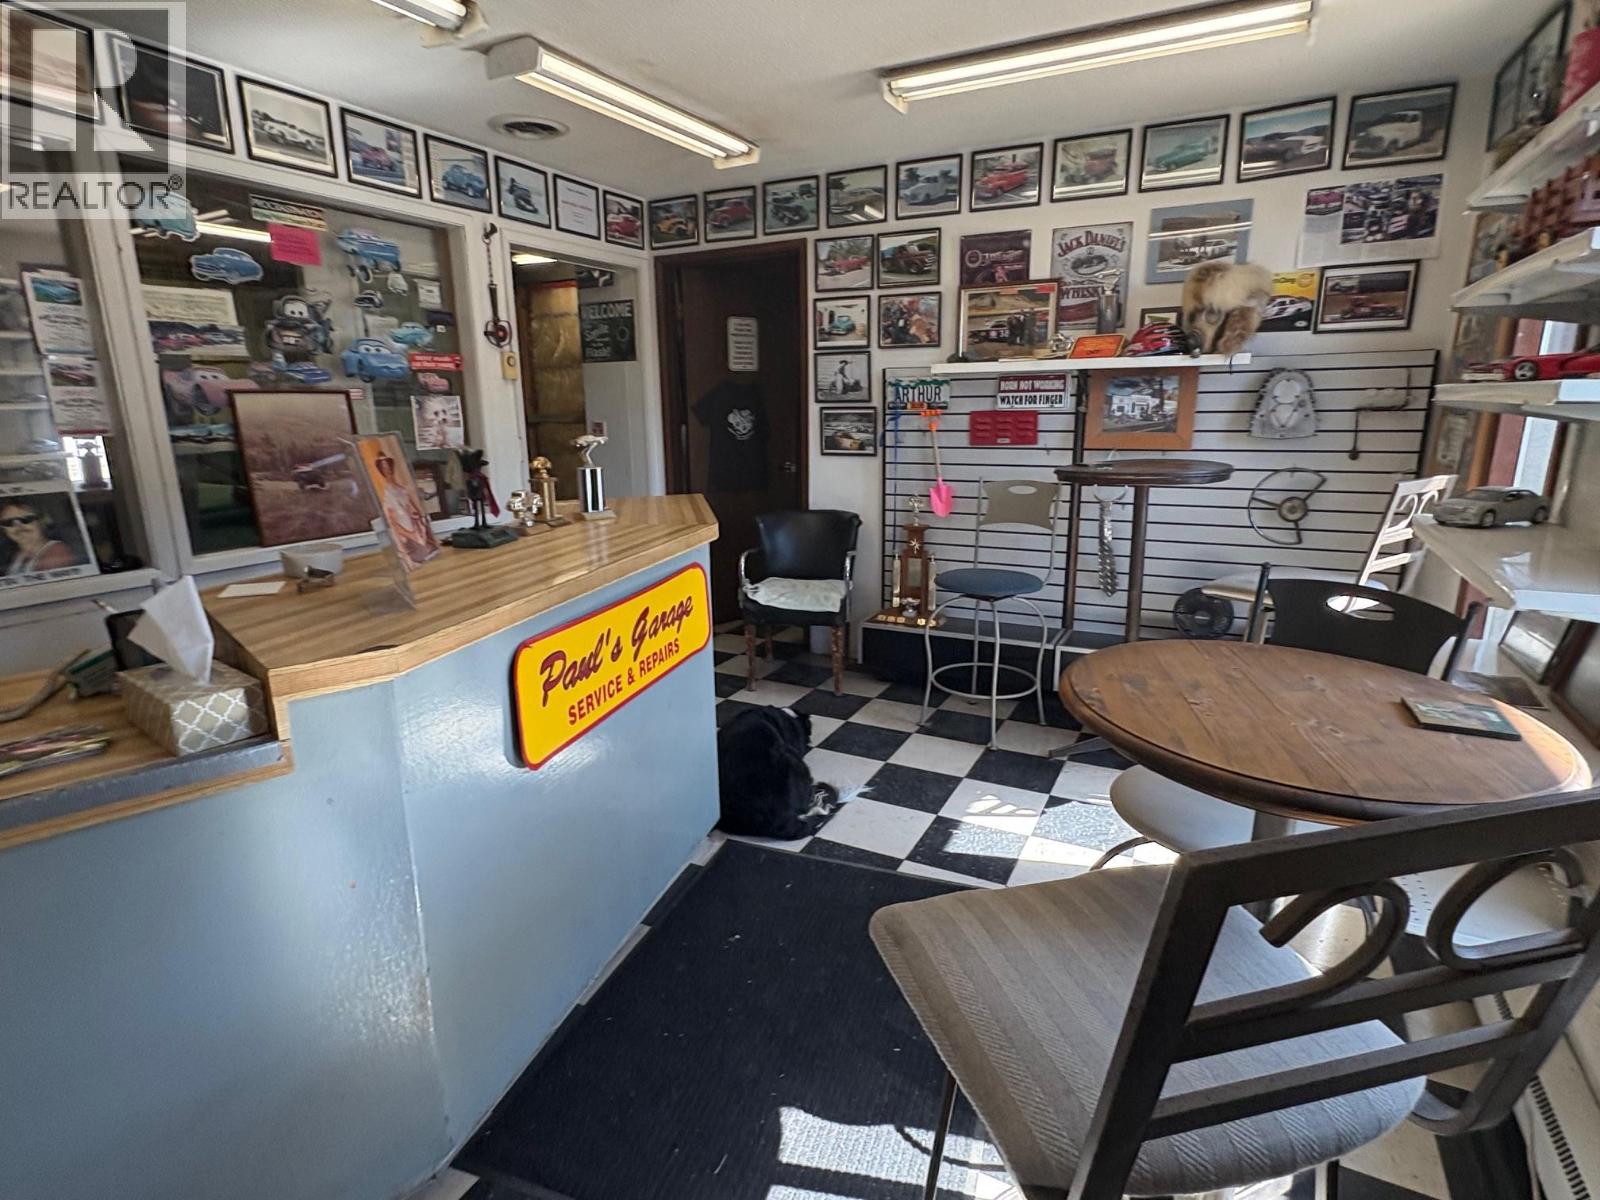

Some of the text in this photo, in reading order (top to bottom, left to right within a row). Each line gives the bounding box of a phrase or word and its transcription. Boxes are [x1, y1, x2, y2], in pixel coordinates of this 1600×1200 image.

[1057, 235, 1084, 258] JACK
[894, 385, 942, 403] ARTHUR
[1000, 393, 1064, 406] WATCH FOR FINGER
[539, 595, 694, 708] Paul's Garage
[568, 637, 680, 726] SERVICE & REPAIRS
